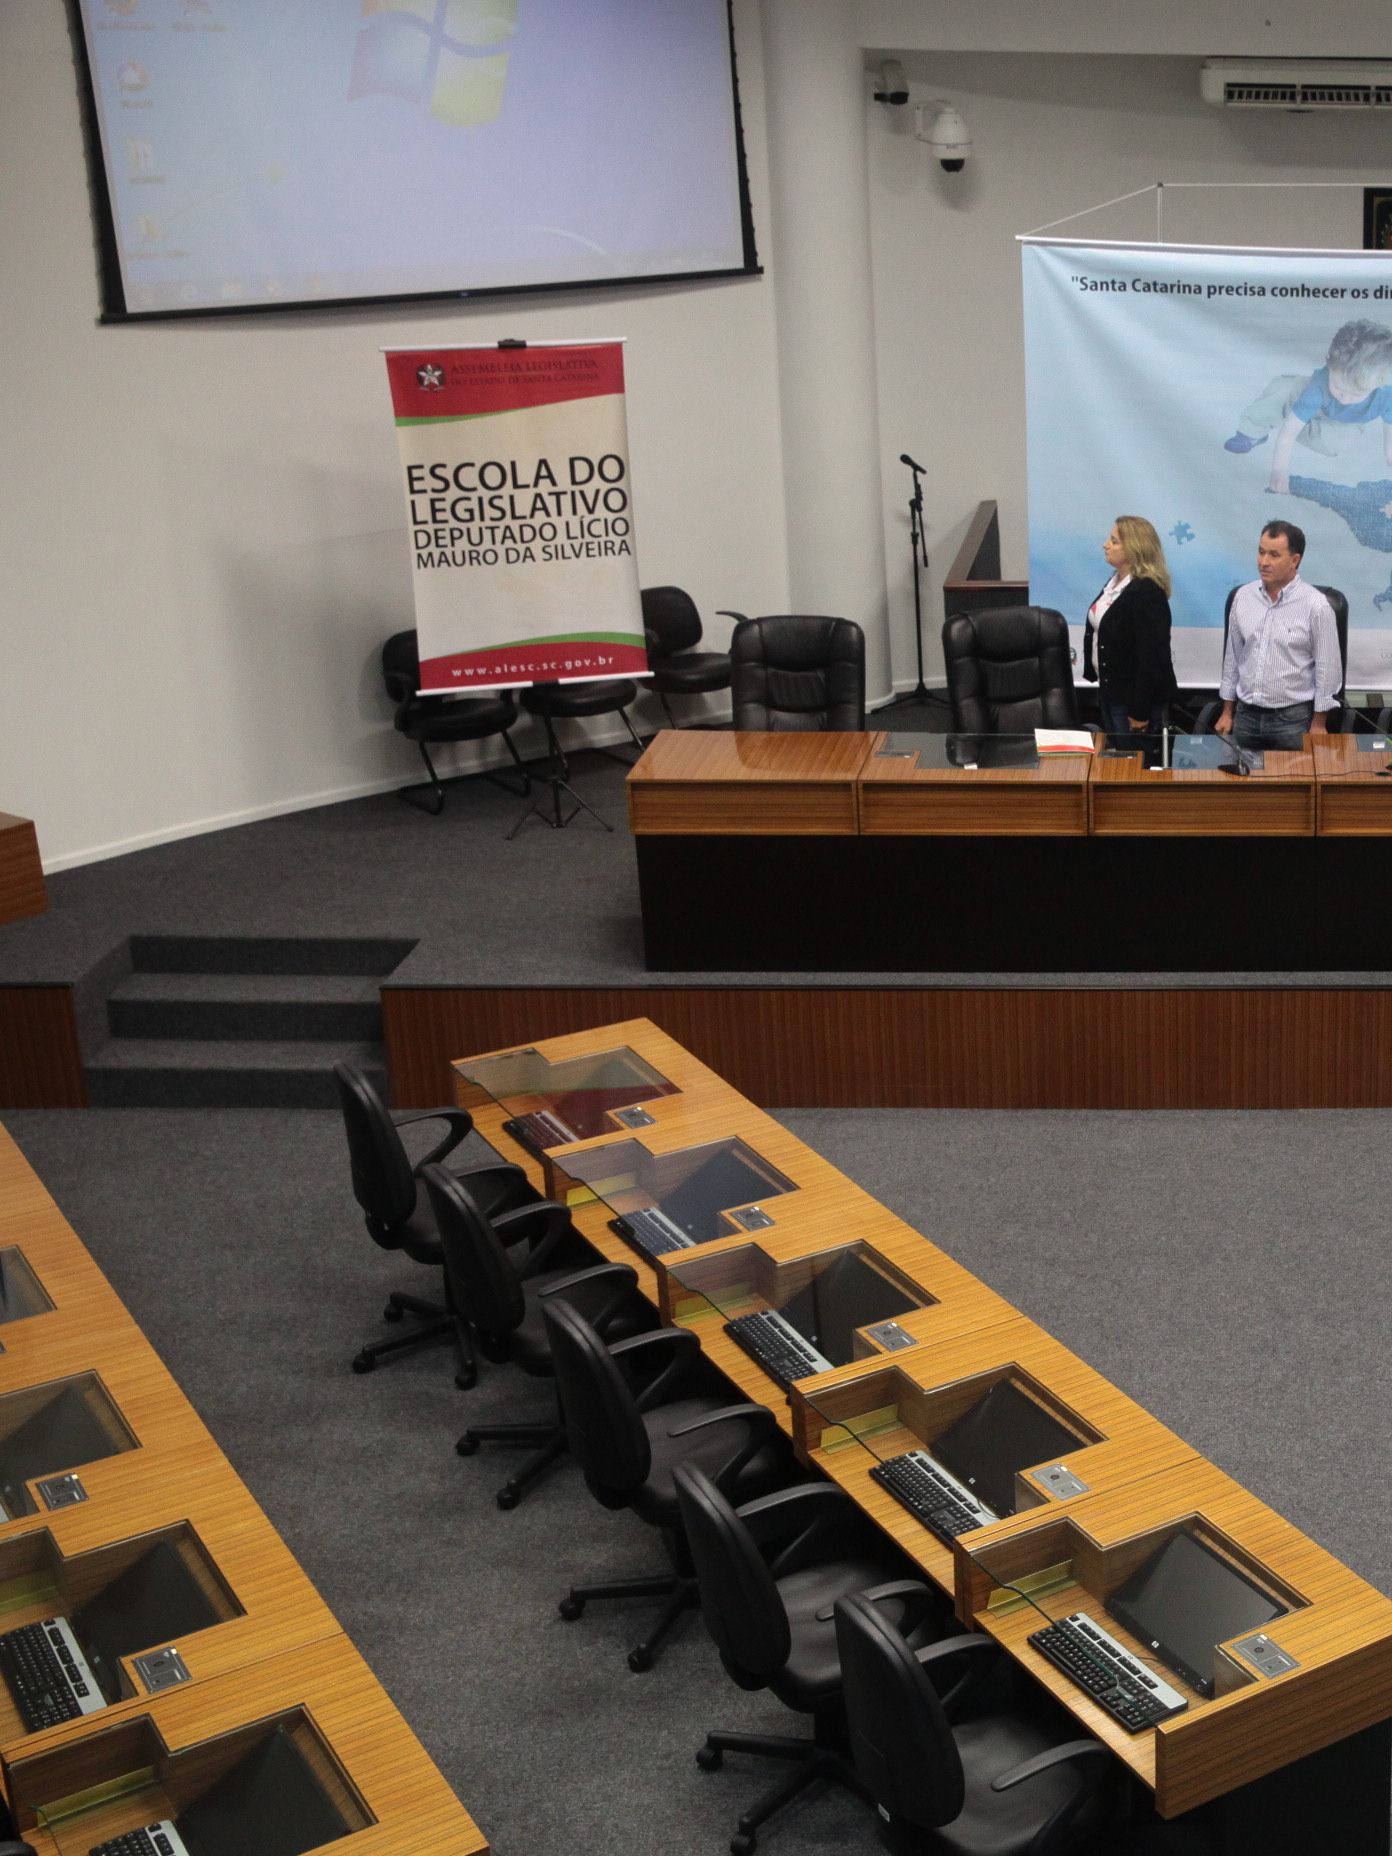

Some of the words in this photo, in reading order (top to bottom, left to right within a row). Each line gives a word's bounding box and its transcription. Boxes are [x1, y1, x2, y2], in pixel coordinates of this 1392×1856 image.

[1071, 276, 1127, 292] "Santa
[1131, 278, 1202, 295] Catarina
[1206, 281, 1266, 299] precisa
[1270, 283, 1348, 299] conhecer
[1350, 287, 1369, 299] os
[406, 458, 558, 495] ESCOLA
[568, 453, 625, 487] DO
[410, 486, 628, 526] LEGISLATIVO
[414, 521, 557, 550] DEPUTADO
[565, 515, 630, 541] LÍCIO
[416, 548, 499, 570] MAURO
[505, 546, 536, 565] DA
[541, 539, 632, 562] SILVEIRA
[451, 655, 614, 677] www.alesc.sc.gov.br
